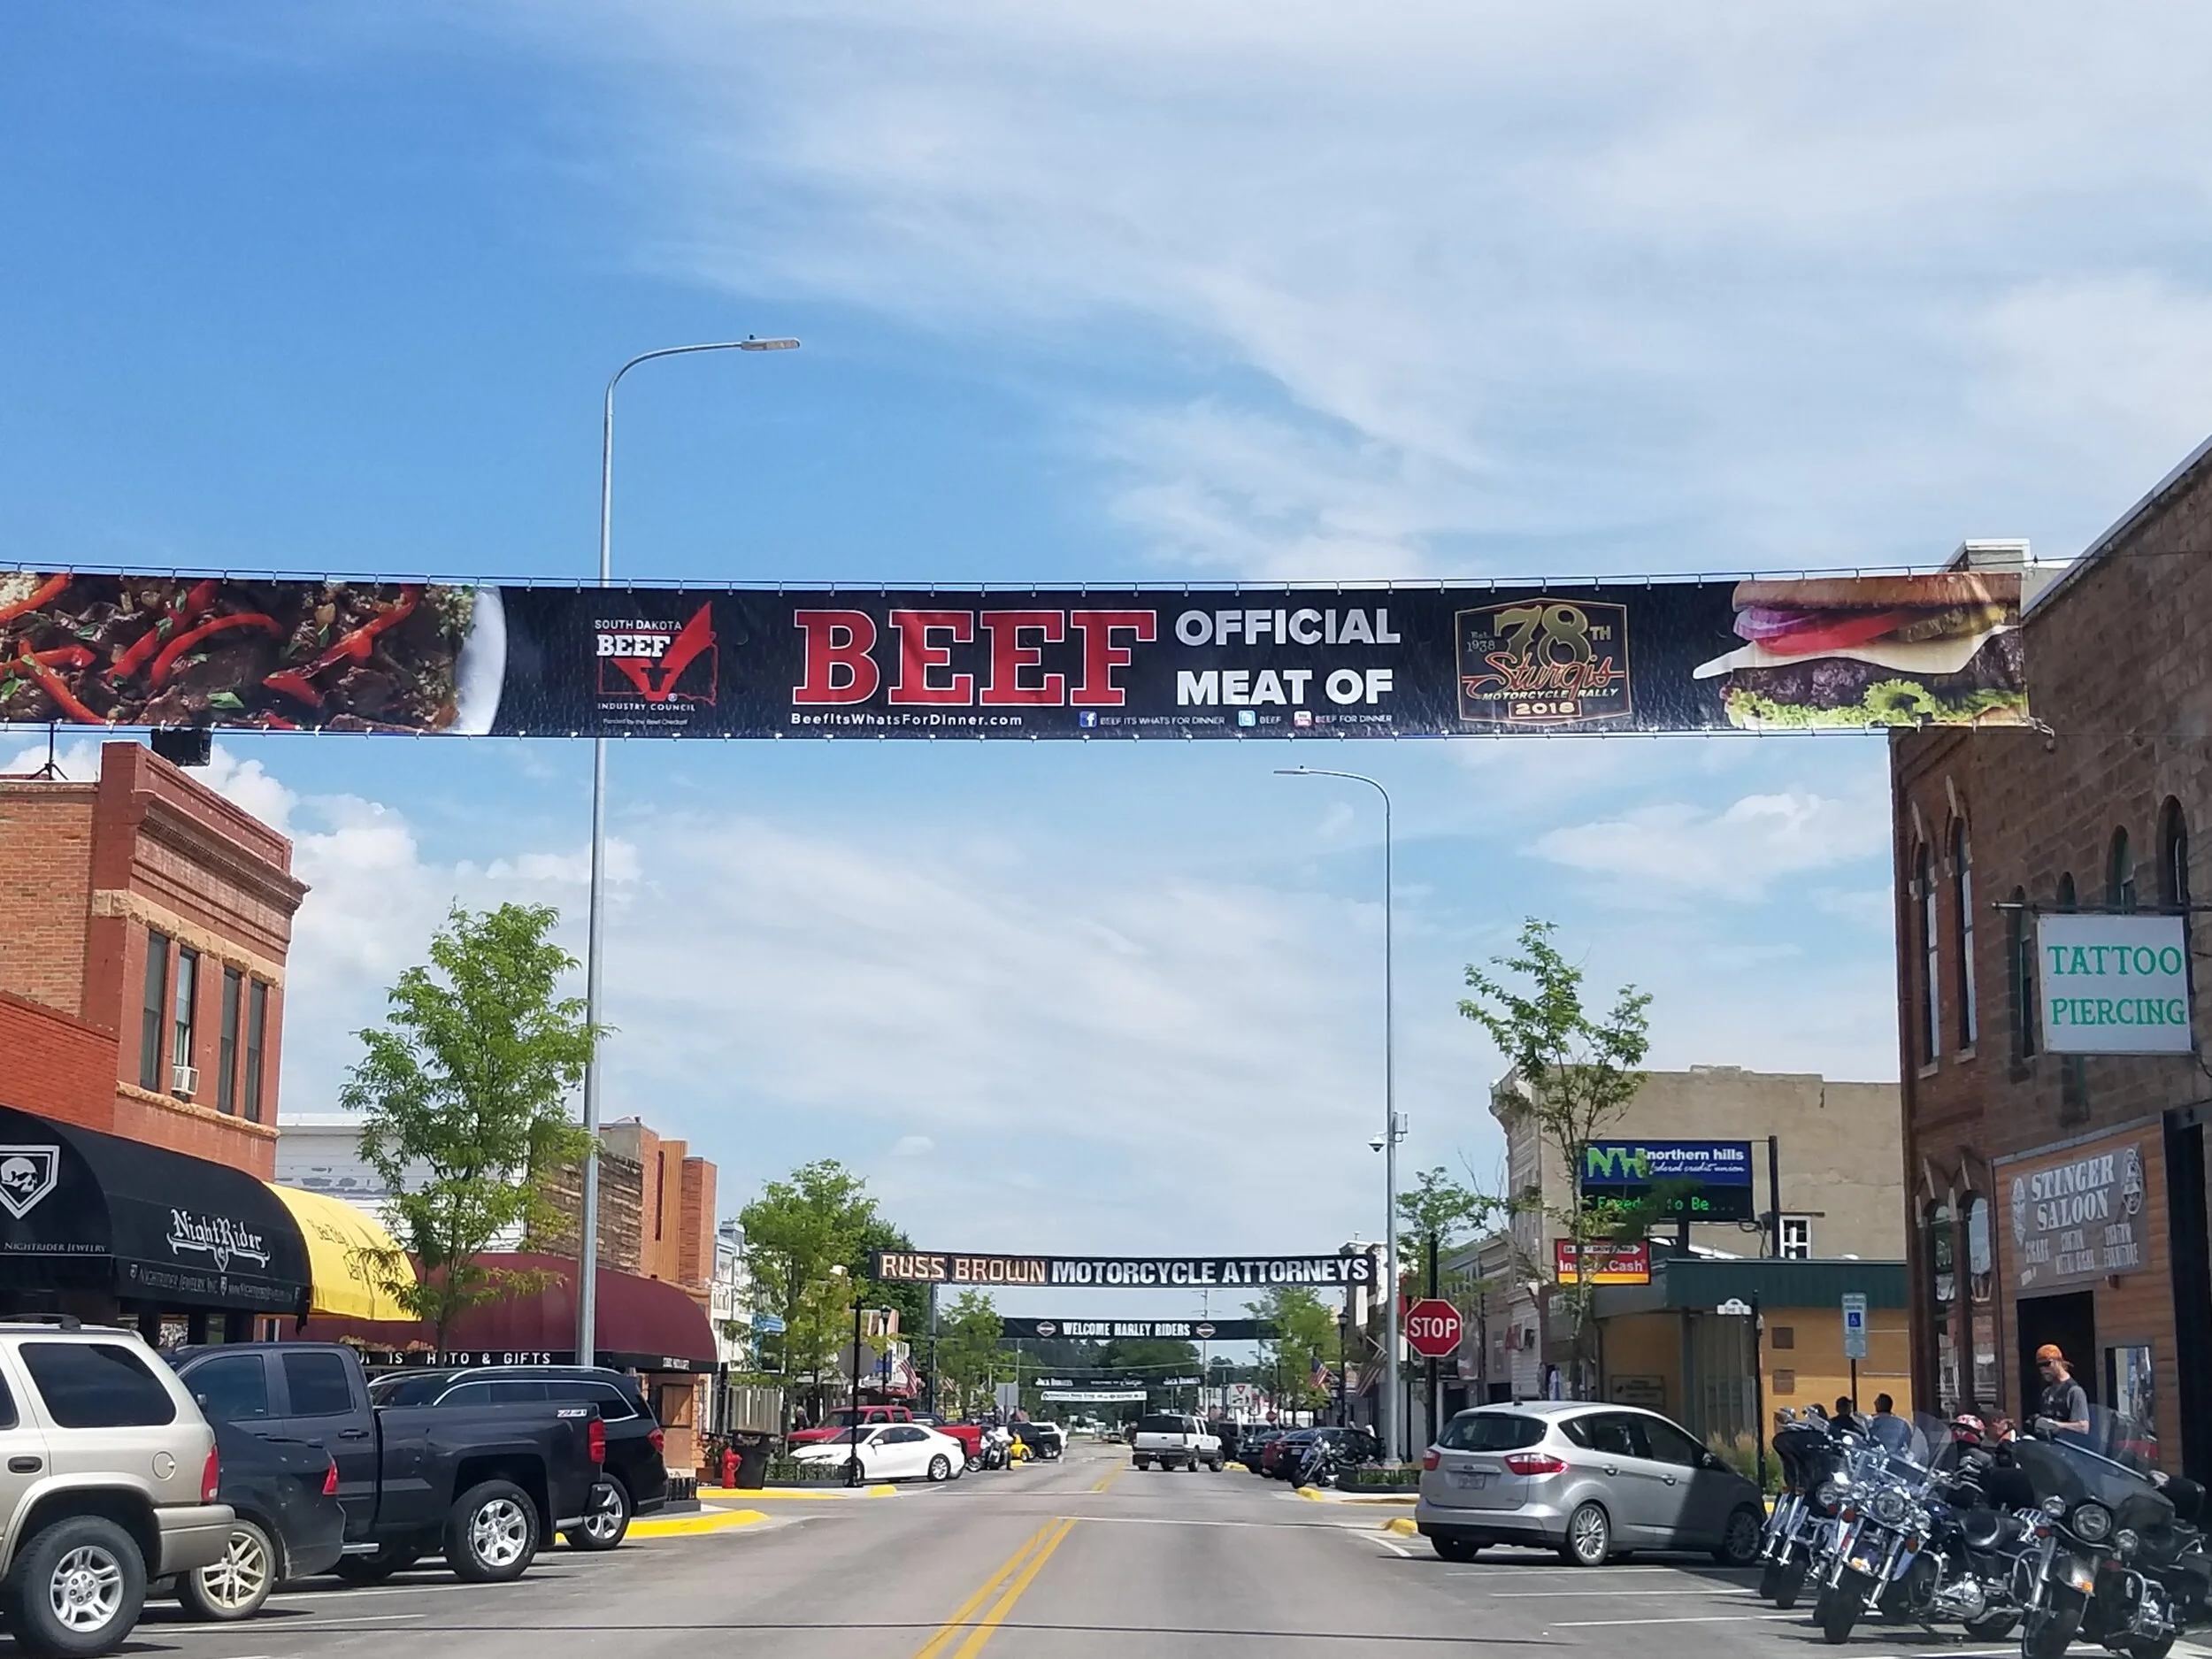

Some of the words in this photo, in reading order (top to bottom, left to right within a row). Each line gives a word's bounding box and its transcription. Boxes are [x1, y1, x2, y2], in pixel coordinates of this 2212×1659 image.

[595, 619, 634, 629] SOUTH
[636, 620, 683, 630] DAKOTA
[1175, 608, 1401, 646] OFFICIAL
[596, 634, 671, 657] BEEF
[1466, 640, 1495, 653] 1938
[793, 609, 1157, 707] BEEF
[1177, 670, 1313, 706] MEAT
[1325, 669, 1394, 705] OF
[1462, 652, 1625, 701] Sturgis
[1481, 690, 1570, 701] MOTORCYCLE
[1578, 687, 1618, 698] RALLY
[791, 713, 1023, 726] BeefItsWhatsForDinner.com
[1516, 702, 1575, 715] 2018
[1124, 717, 1137, 726] ITS
[1139, 716, 1170, 726] WHATS
[1172, 717, 1190, 726] FOR
[1192, 716, 1225, 726] DINNER
[2047, 945, 2182, 975] TATTOO
[2050, 998, 2187, 1025] PIERCING
[1647, 1149, 1709, 1161] northern
[1713, 1148, 1745, 1161] hills
[2032, 1154, 2115, 1202] STINGER
[2037, 1187, 2109, 1231] SALOON
[171, 1209, 263, 1256] NightRider
[881, 1254, 946, 1279] RUSS
[954, 1257, 1046, 1282] BROWN
[1051, 1261, 1217, 1283] MOTORCYCLE
[1222, 1258, 1369, 1282] ATTORNEYS
[1609, 1259, 1643, 1272] Cash
[1063, 1322, 1110, 1336] WELCOME
[1114, 1323, 1151, 1337] HARLEY
[1155, 1323, 1191, 1337] RIDERS
[1409, 1317, 1458, 1339] STOP
[481, 1352, 492, 1364] &
[503, 1352, 551, 1364] GIFTS
